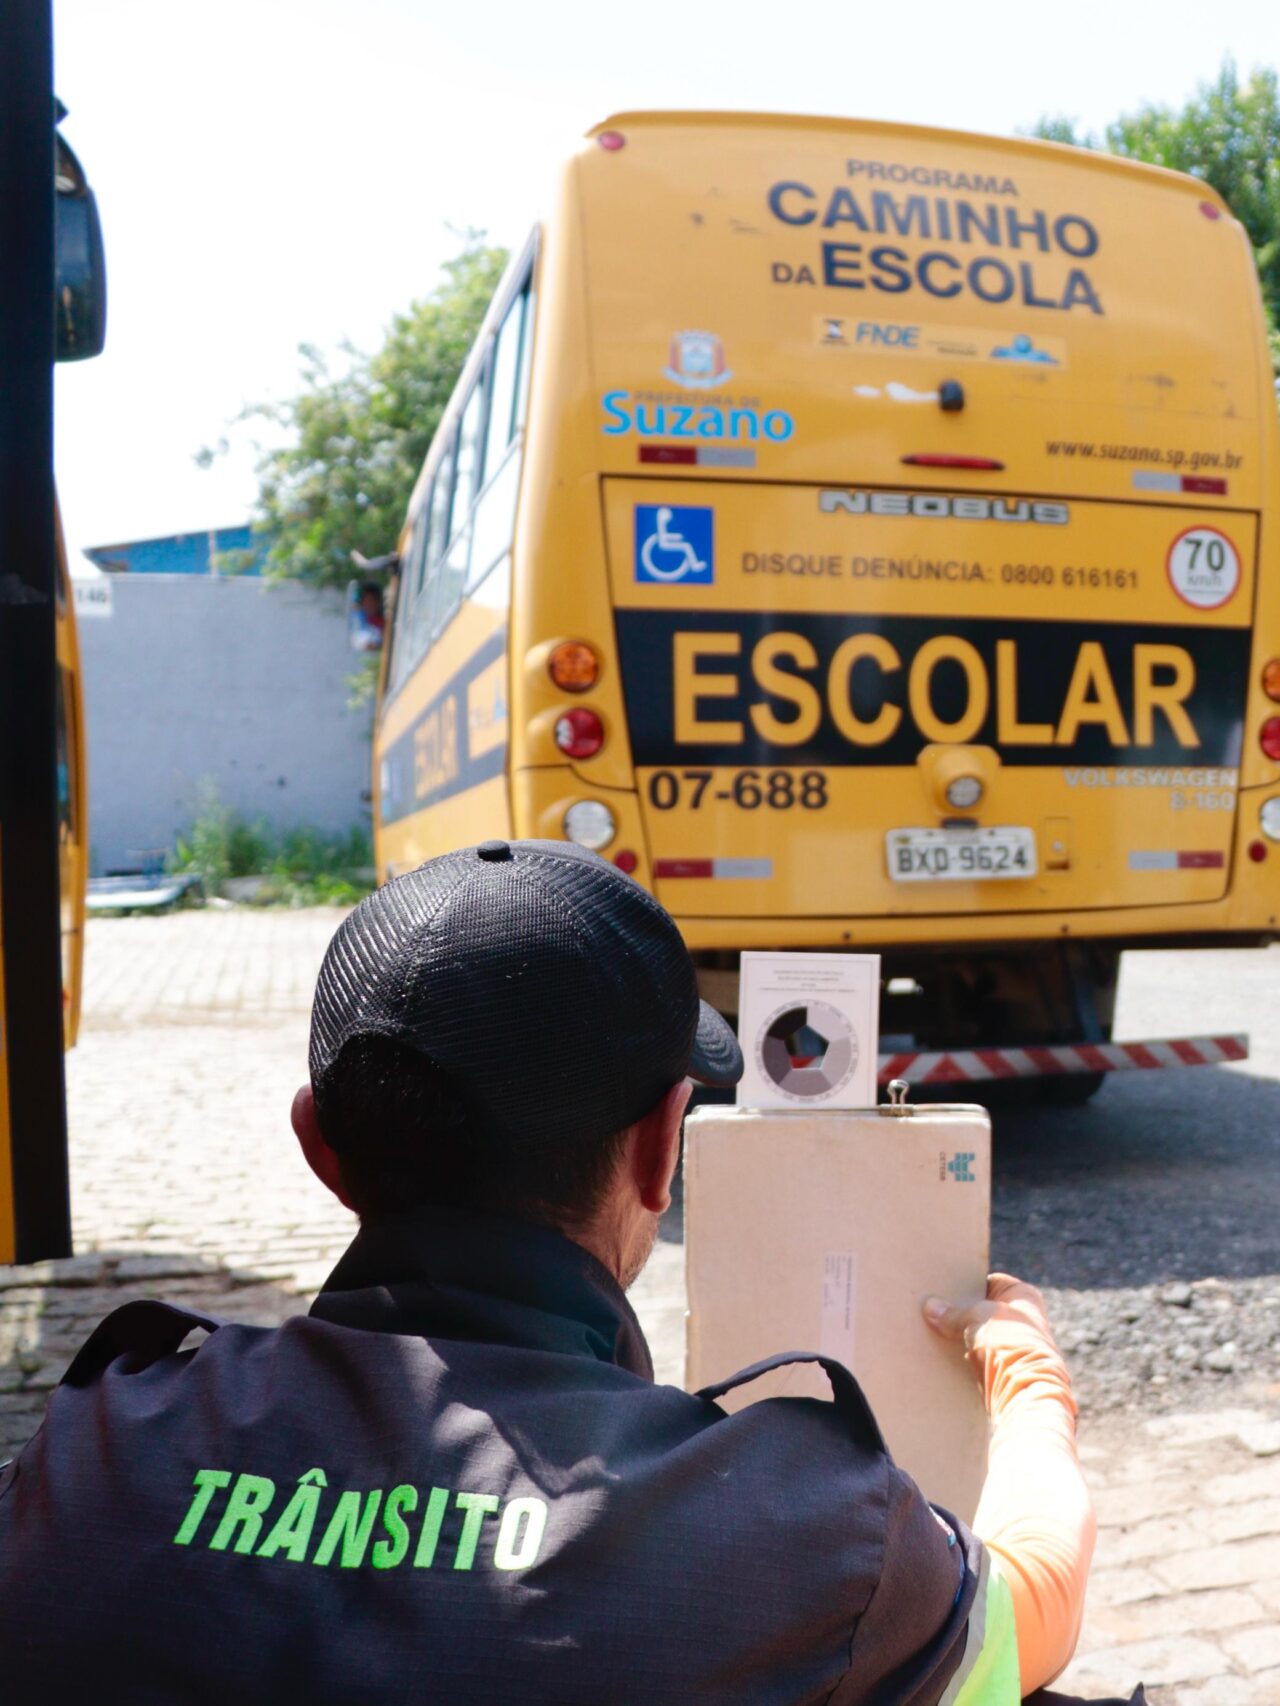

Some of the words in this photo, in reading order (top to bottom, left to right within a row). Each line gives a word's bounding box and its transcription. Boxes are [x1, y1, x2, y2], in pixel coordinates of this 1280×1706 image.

[846, 158, 1019, 196] PROGRAMA
[767, 180, 1099, 259] CAMINHO
[771, 262, 816, 285] DA
[821, 240, 1105, 315] ESCOLA
[855, 321, 921, 348] FNDE
[602, 389, 794, 442] Suzano
[1046, 440, 1243, 470] www.suzano.sp.gov.br
[819, 490, 1070, 525] NEOBUS
[741, 551, 842, 577] DISQUE
[851, 554, 993, 583] DENÚNCIA:
[1001, 563, 1054, 586] 0800
[1062, 566, 1139, 589] 616161
[1184, 537, 1226, 572] 70
[673, 631, 1200, 748] ESCOLAR
[649, 771, 829, 811] 07-688
[1063, 767, 1236, 787] VOLKSWAGEN
[173, 1467, 548, 1571] TRÂNSITO
